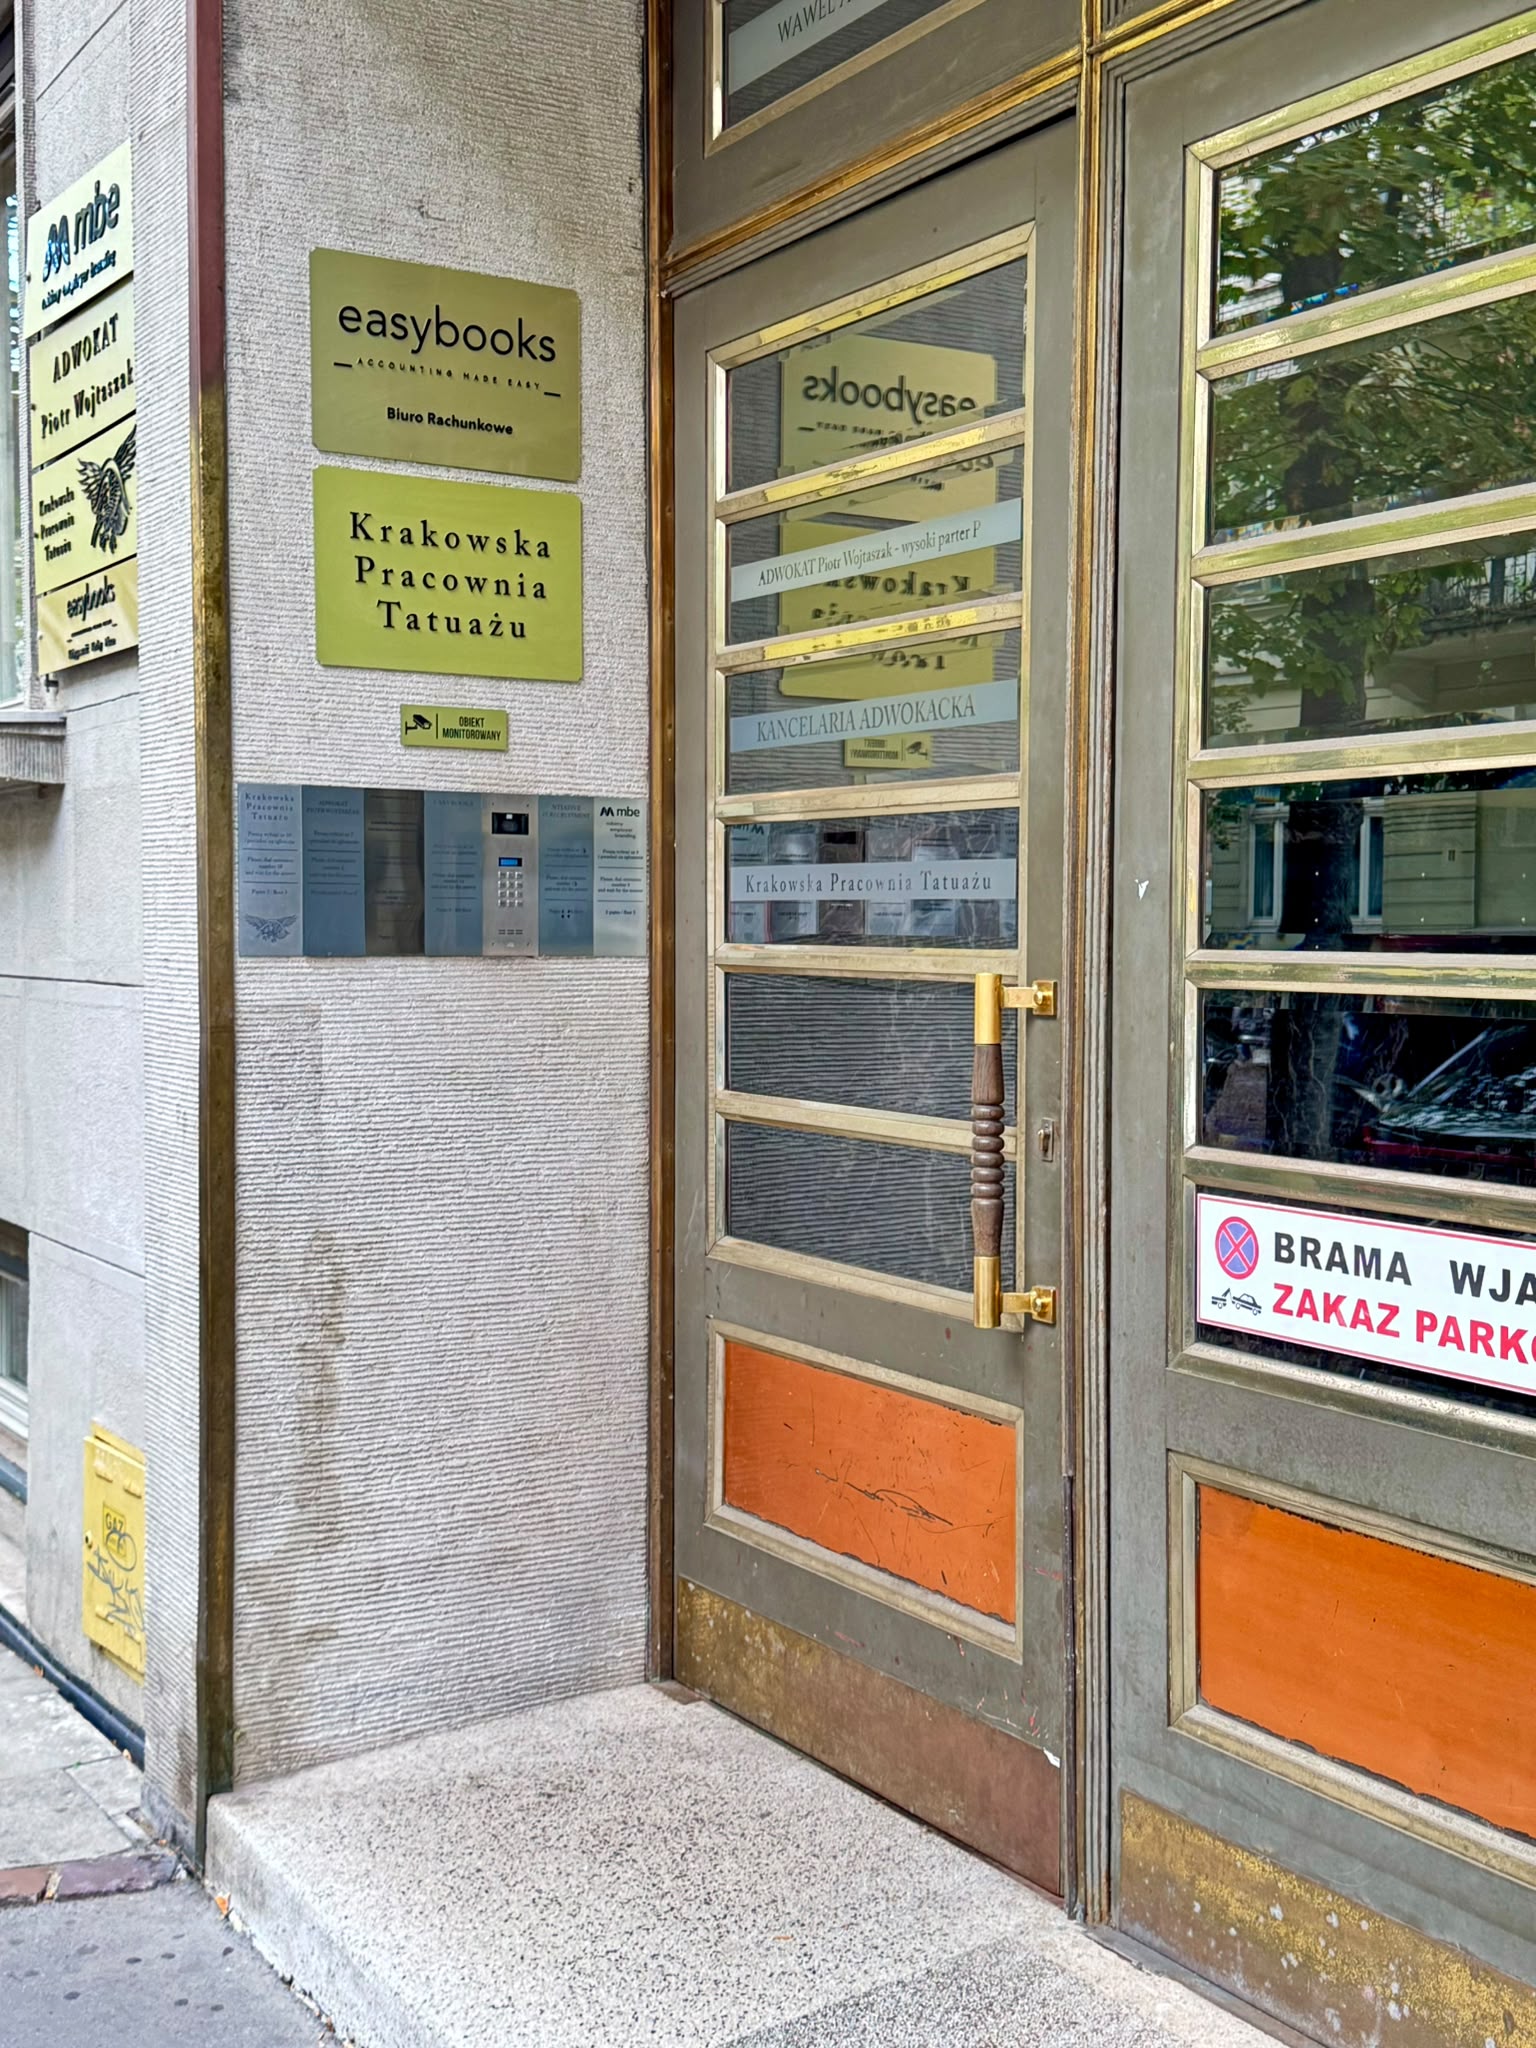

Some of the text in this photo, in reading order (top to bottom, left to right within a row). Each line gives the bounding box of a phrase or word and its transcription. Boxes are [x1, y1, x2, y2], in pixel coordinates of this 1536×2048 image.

[73, 179, 121, 256] mbe
[53, 313, 119, 383] ADWOKAT
[338, 304, 557, 362] easybooks
[356, 357, 540, 391] ACCOUNTING MADE EASY
[41, 358, 134, 440] Piotr Wojtaszak
[387, 406, 514, 435] Biuro Rachunkowe
[349, 511, 551, 558] Krakowska
[758, 559, 817, 587] ADWOKAT
[817, 555, 841, 576] Piotr
[843, 541, 893, 570] Wojtaszak
[900, 533, 936, 559] wysoki
[938, 528, 970, 550] parter
[972, 520, 981, 538] P
[354, 555, 547, 599] Pracownia
[377, 600, 527, 638] Tatuażu
[442, 727, 501, 741] MONITOROWANY
[459, 716, 485, 728] OBIEKT
[756, 693, 977, 742] KANCELARIA ADWOKACKA
[616, 806, 640, 818] mbe
[745, 870, 992, 893] Krakowska Pracownia Tatuażu
[1274, 1231, 1412, 1286] BRAMA
[1449, 1259, 1536, 1306] WJA
[1272, 1283, 1401, 1338] ZAKAZ
[1416, 1309, 1536, 1365] PARK
